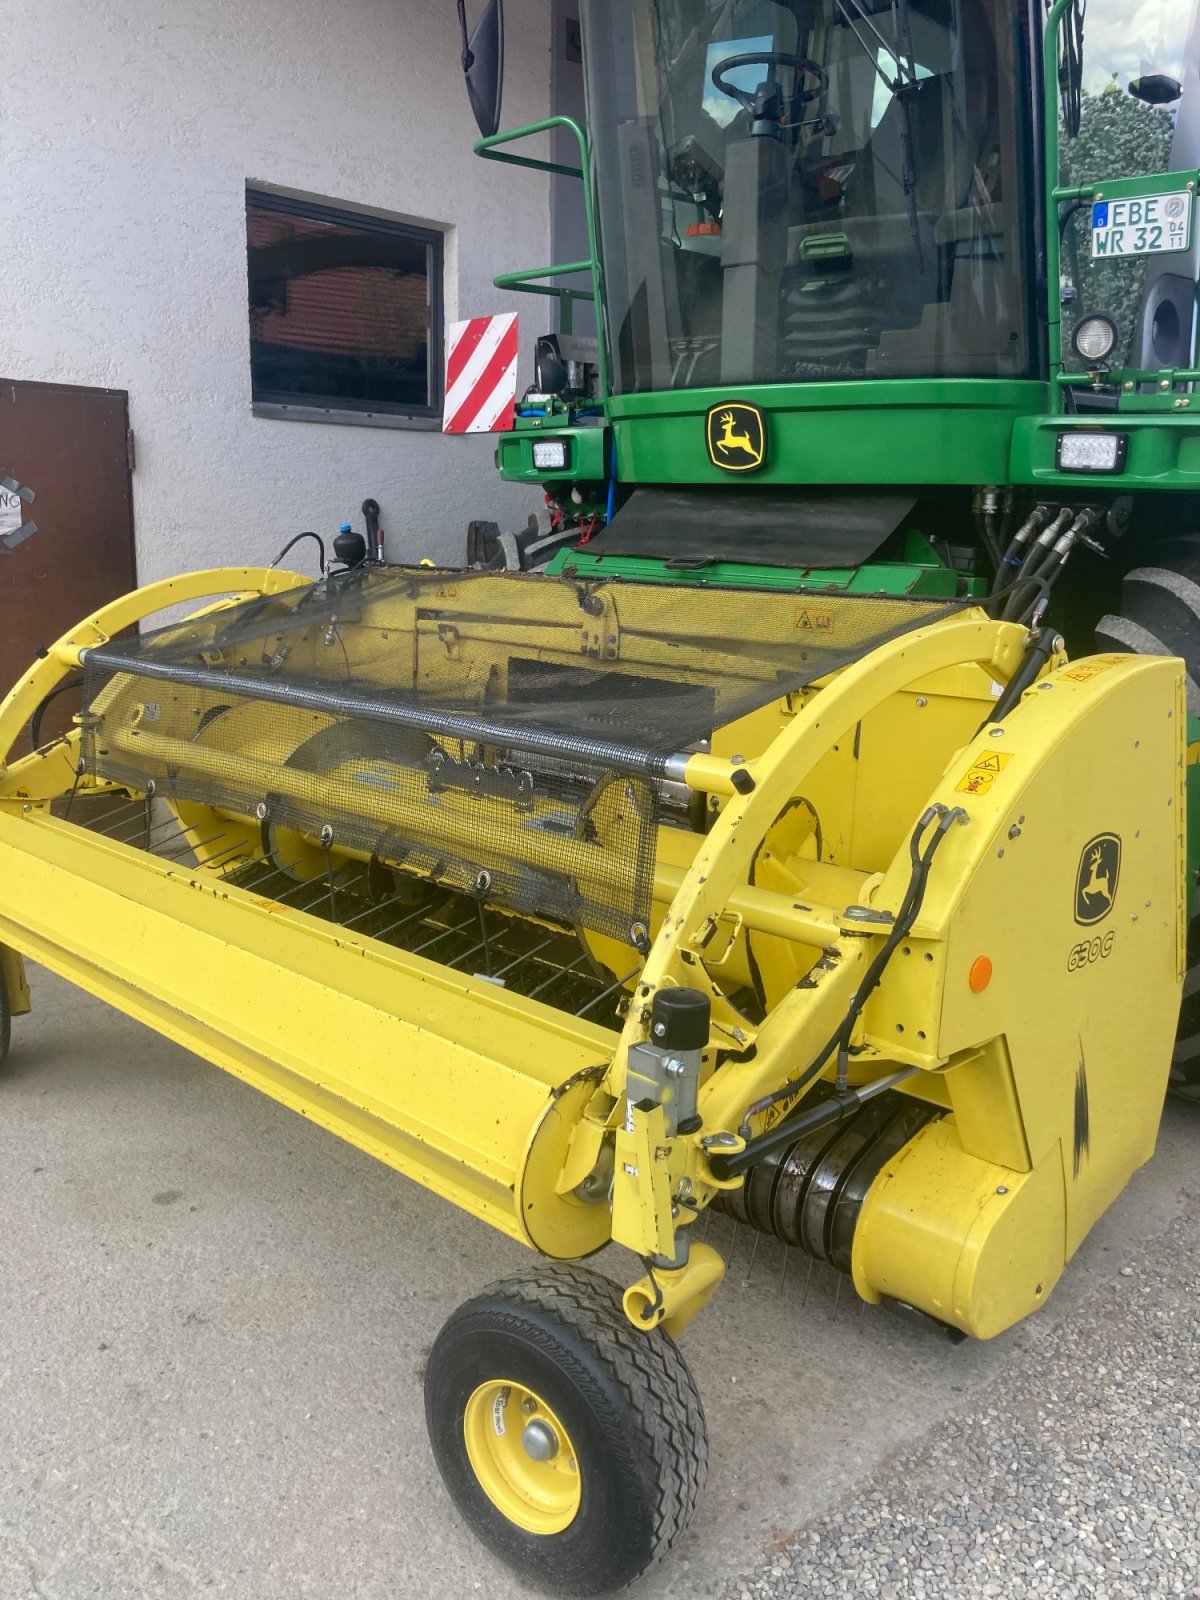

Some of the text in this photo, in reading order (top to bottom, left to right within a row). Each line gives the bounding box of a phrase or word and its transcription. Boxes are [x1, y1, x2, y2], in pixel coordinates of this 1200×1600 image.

[1098, 218, 1103, 227] D
[1113, 199, 1158, 227] EBE
[1170, 221, 1184, 232] 04
[1096, 226, 1163, 255] WR 32
[1171, 236, 1182, 248] 11
[1068, 930, 1115, 973] 630C
